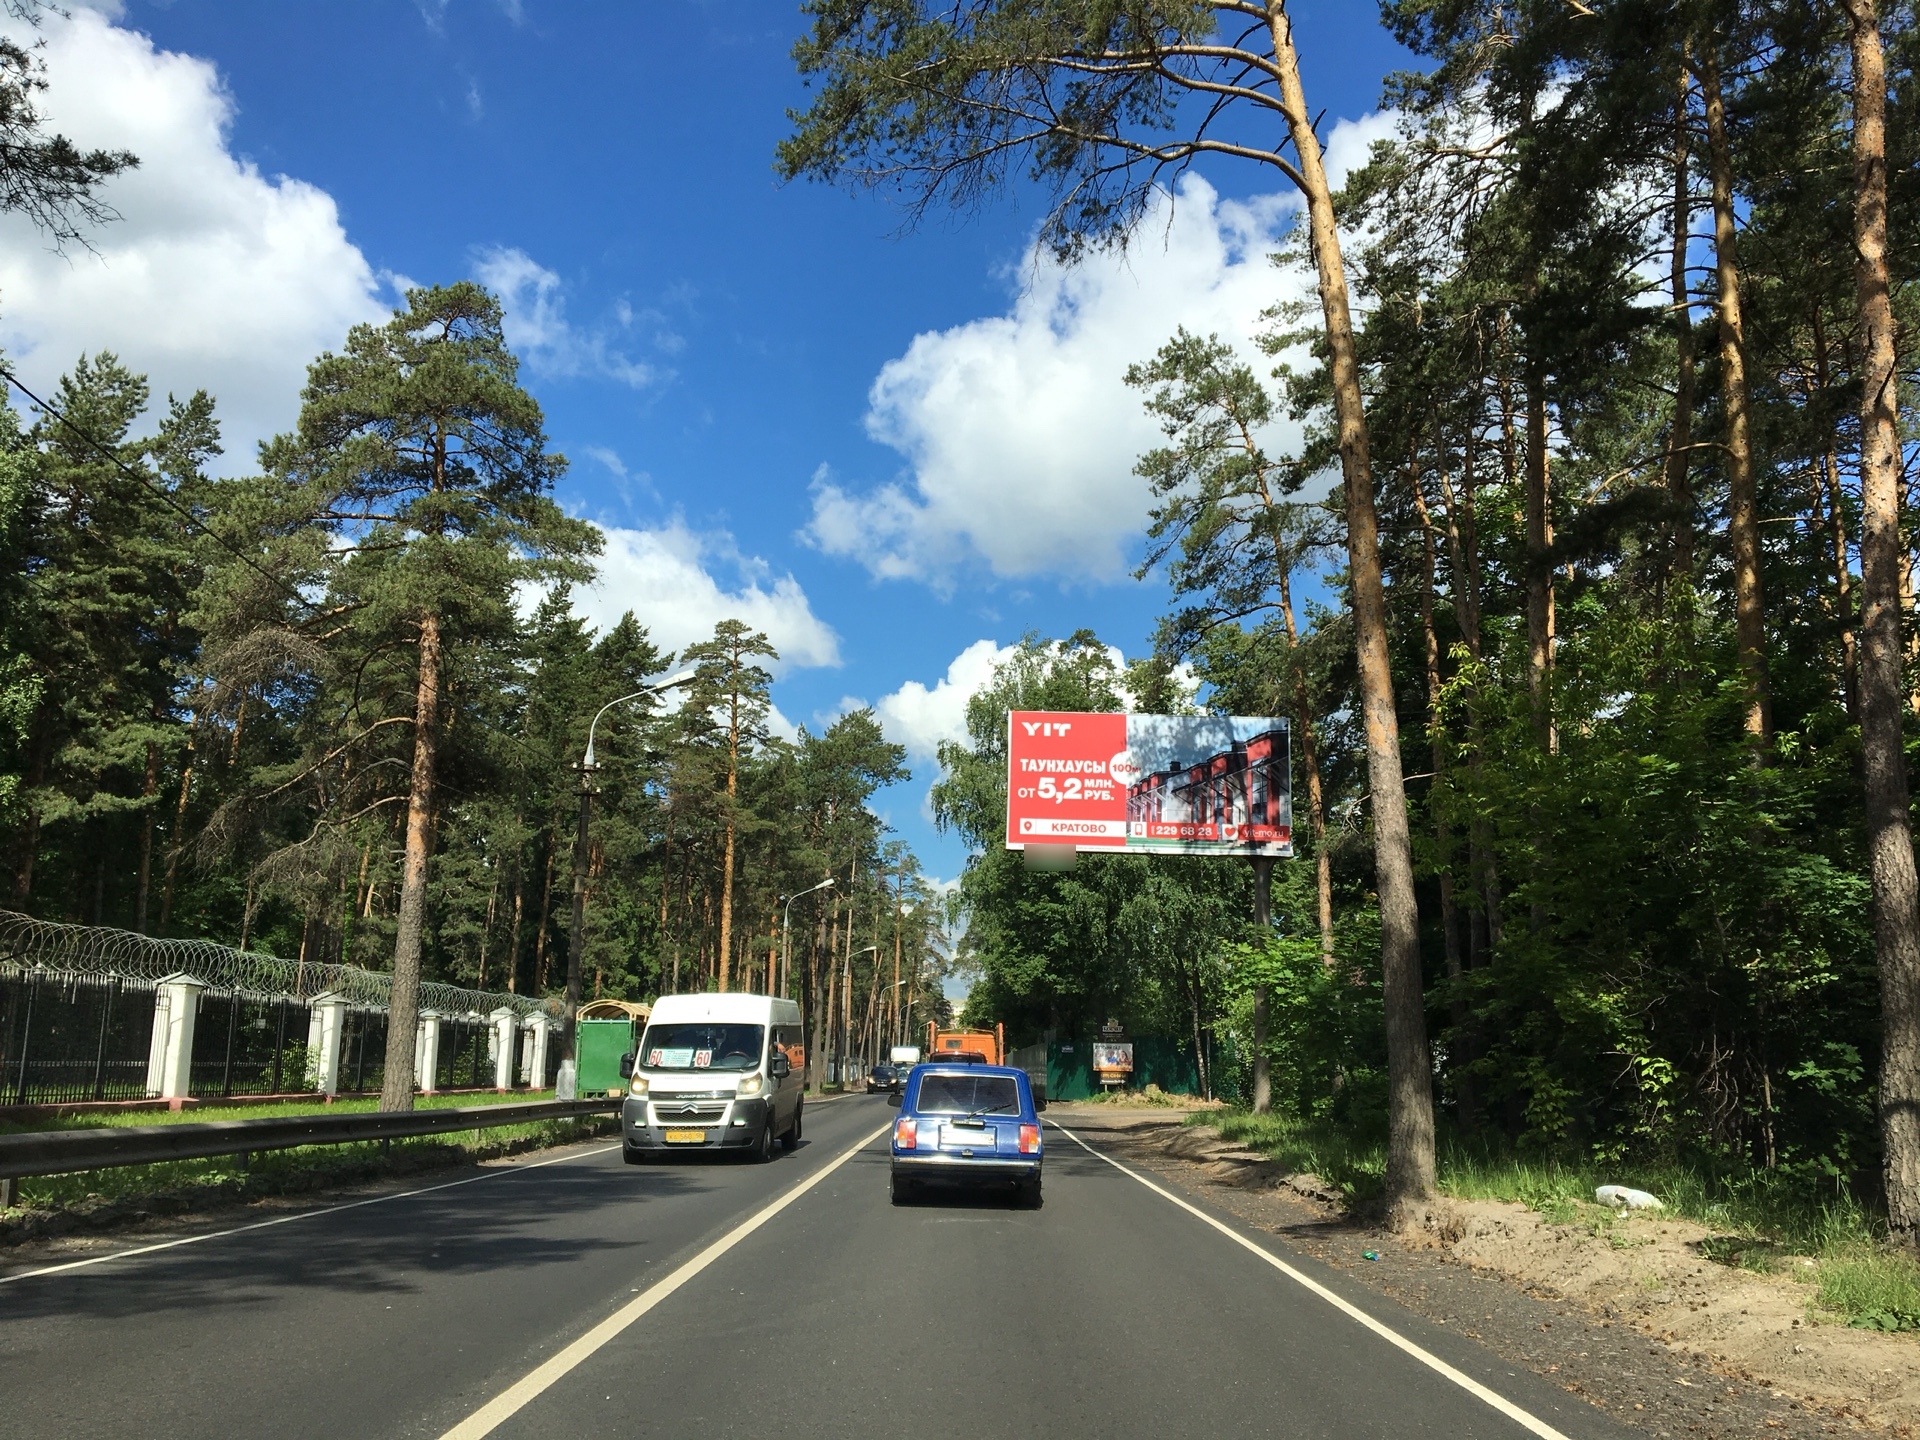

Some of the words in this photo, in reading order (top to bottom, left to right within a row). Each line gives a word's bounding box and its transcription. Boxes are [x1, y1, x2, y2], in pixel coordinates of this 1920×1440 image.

[1021, 722, 1071, 737] YIT
[1020, 758, 1106, 774] ТАУНХАУСЫ
[1017, 787, 1036, 798] ОТ
[1037, 776, 1082, 805] 5,2
[1084, 778, 1115, 789] МЛН.
[1084, 789, 1115, 801] РУБ.
[1051, 822, 1107, 834] КРАТОВО
[1155, 825, 1178, 836] 229
[1180, 826, 1195, 836] 68
[1197, 826, 1213, 837] 28
[696, 1051, 710, 1066] 60
